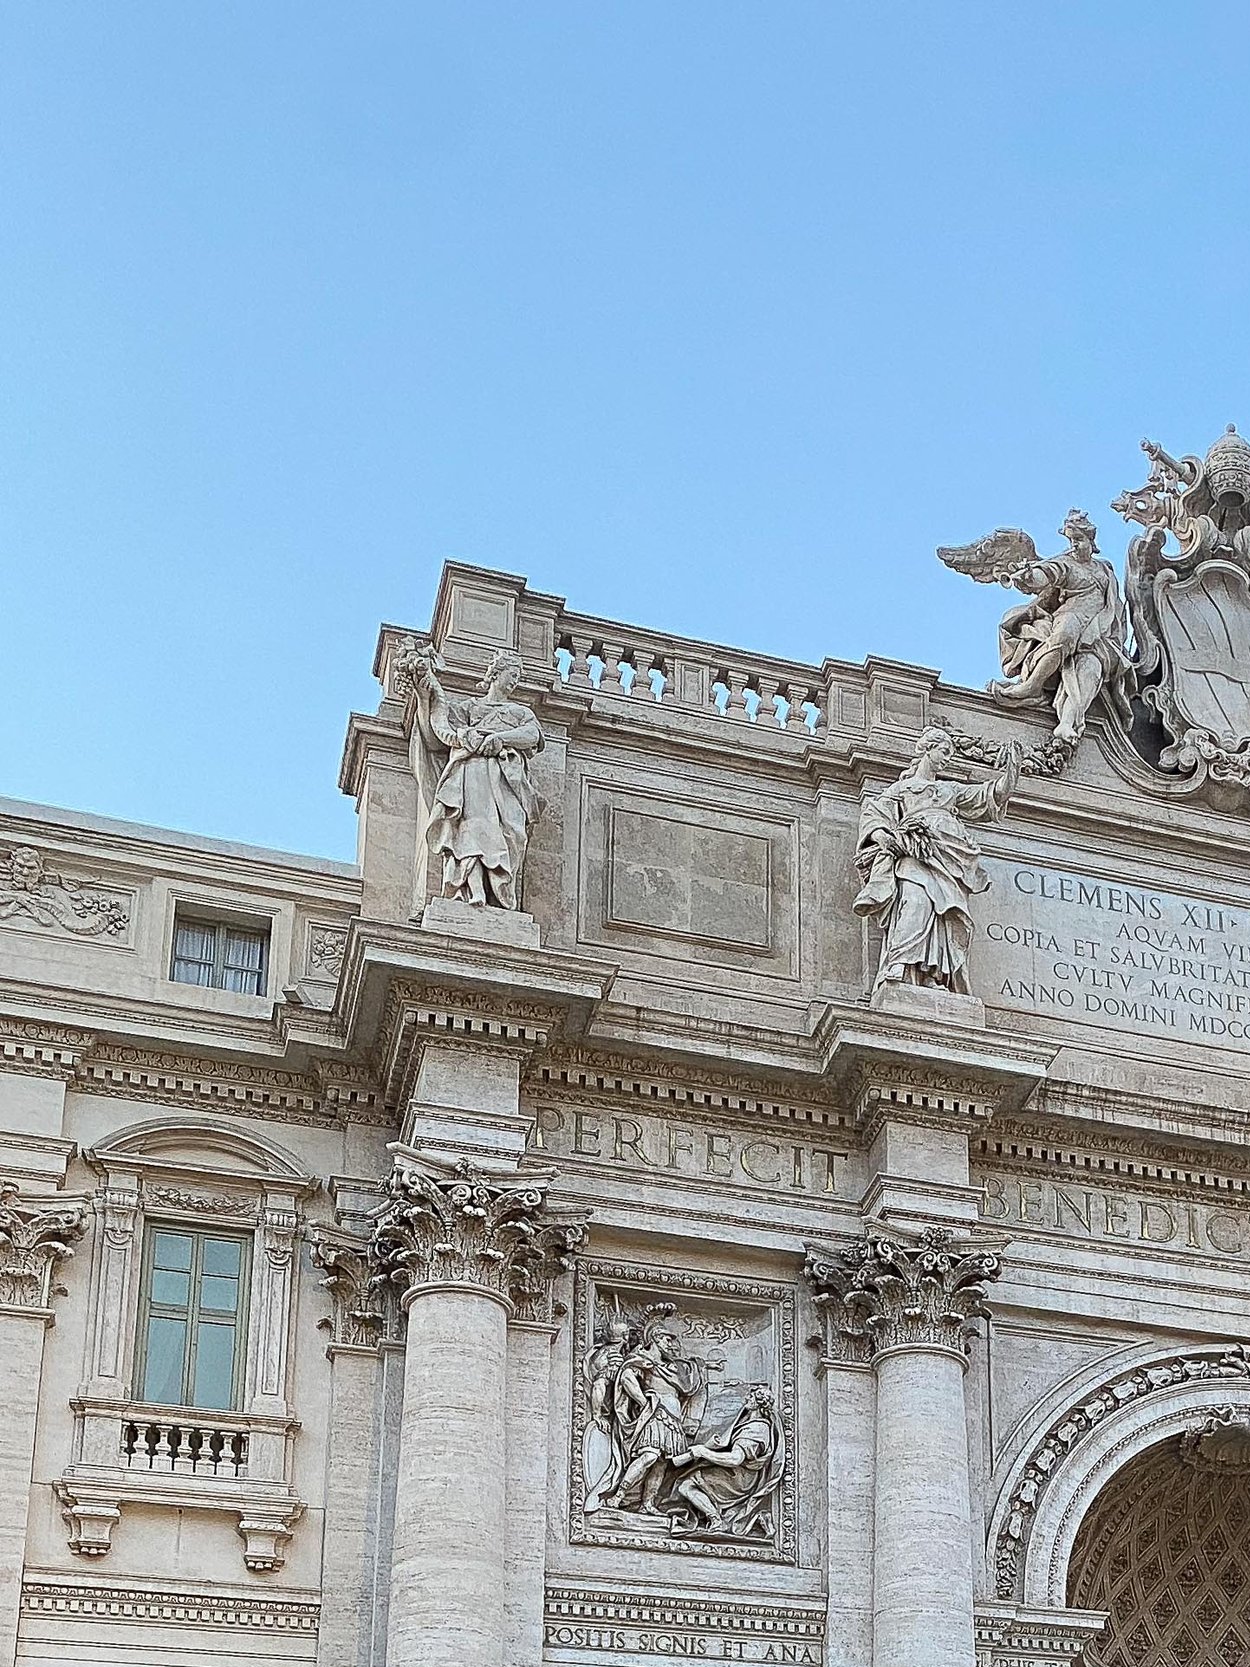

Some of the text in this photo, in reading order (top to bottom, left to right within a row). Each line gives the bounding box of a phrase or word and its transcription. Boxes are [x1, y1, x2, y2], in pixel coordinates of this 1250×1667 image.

[1014, 870, 1162, 920] CLEMENS
[986, 923, 1062, 953] COPIA
[1074, 939, 1100, 960] ET
[1116, 922, 1205, 954] AQVAM
[1053, 962, 1134, 992] CVLTV
[999, 979, 1074, 1007] ANNO
[1085, 993, 1176, 1027] DOMINI
[530, 1105, 848, 1194] PERFECIT
[544, 1626, 816, 1664] POSITIS SIGNIS ET ANA
